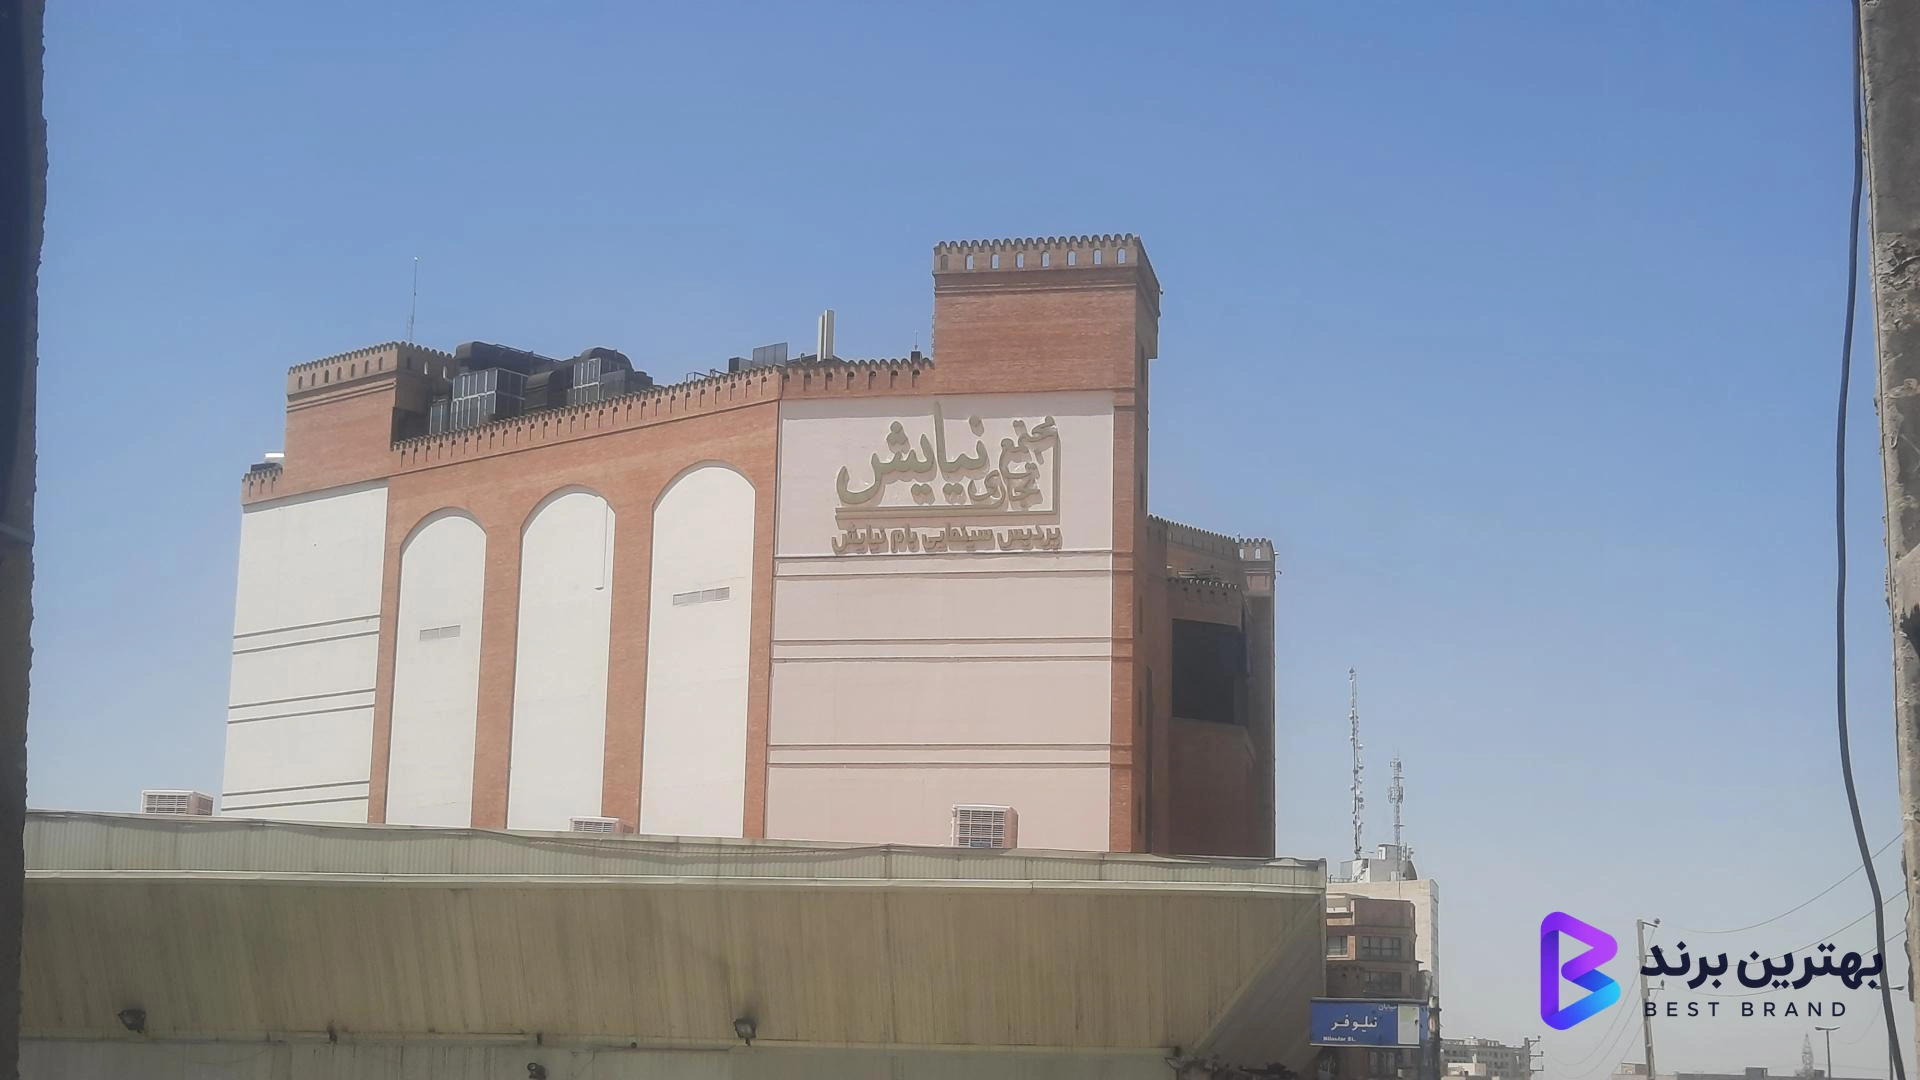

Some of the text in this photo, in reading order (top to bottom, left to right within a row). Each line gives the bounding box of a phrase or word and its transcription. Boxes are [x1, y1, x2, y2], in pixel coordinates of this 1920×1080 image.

[836, 400, 990, 506] نیایش
[832, 524, 1063, 554] پردیس سینمایی بام نیایش
[1331, 1014, 1378, 1032] نیلوفر
